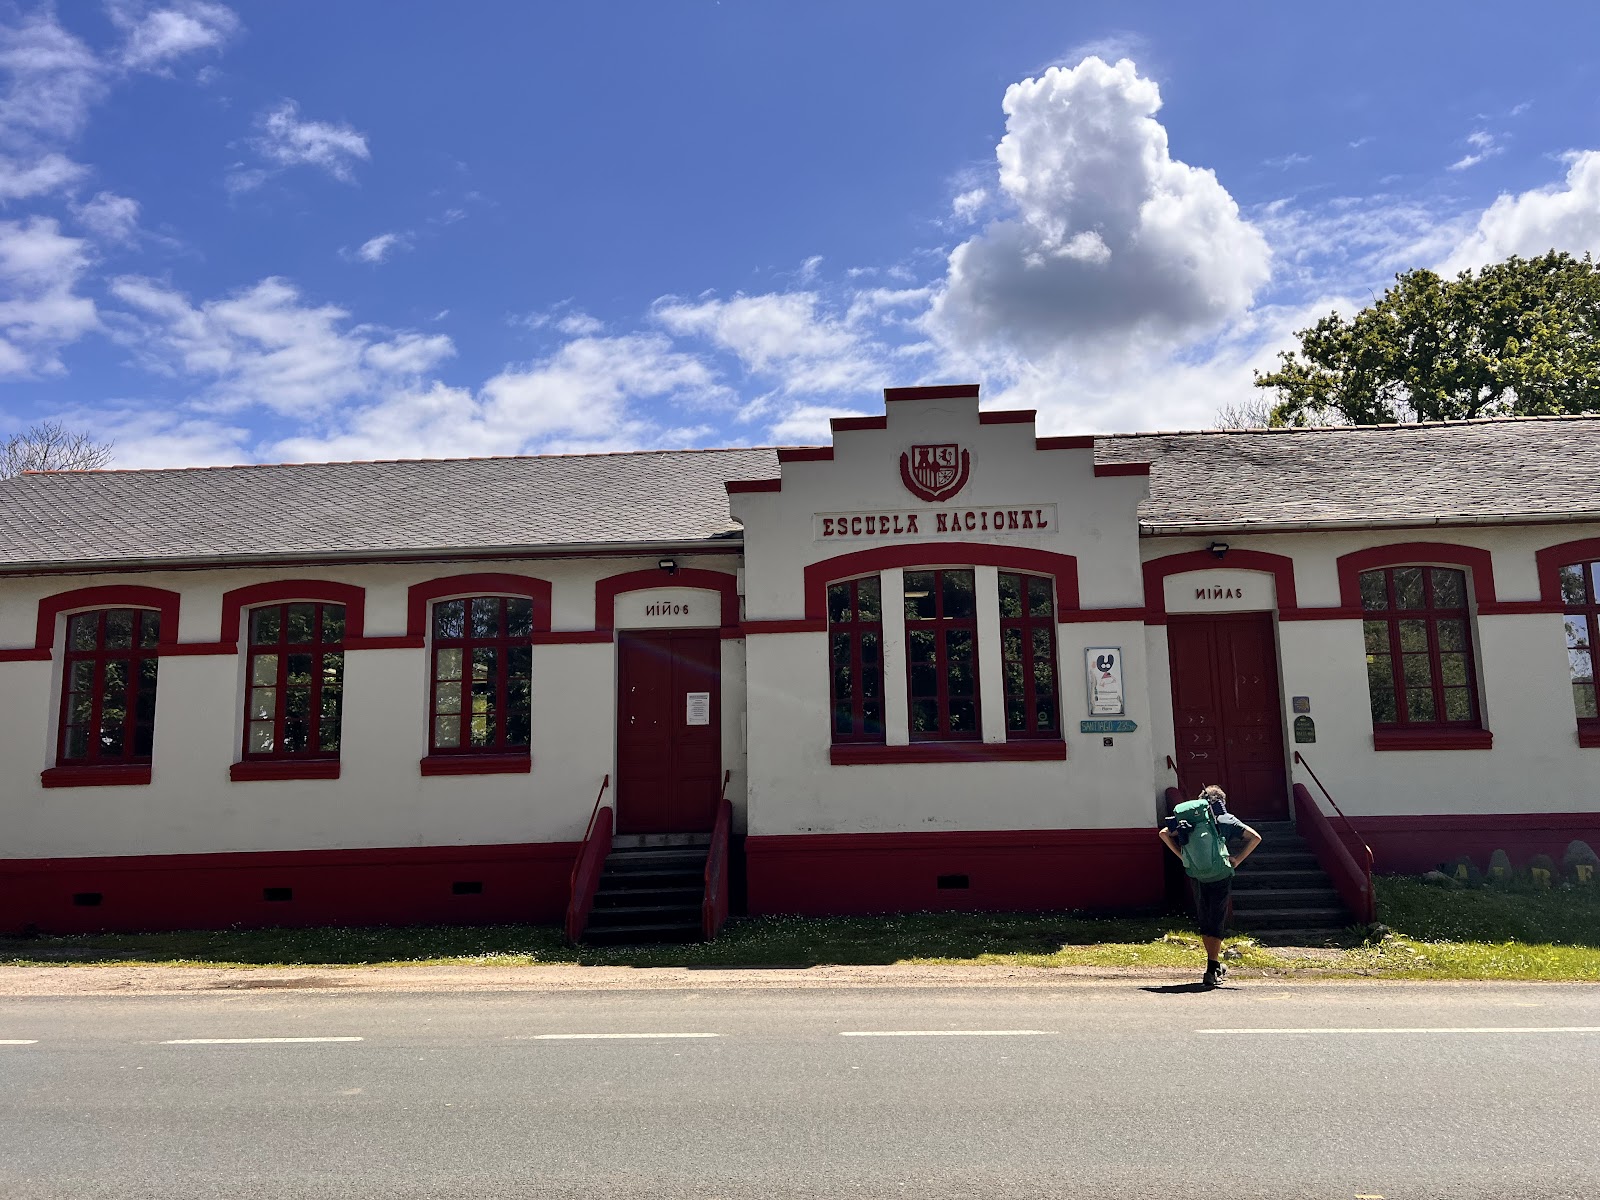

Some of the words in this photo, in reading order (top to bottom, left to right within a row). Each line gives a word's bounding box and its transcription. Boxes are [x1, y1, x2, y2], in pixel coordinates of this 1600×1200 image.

[823, 515, 918, 536] ESCUELA
[937, 510, 1047, 532] NACIONAL
[1081, 721, 1112, 731] SANTIAGO
